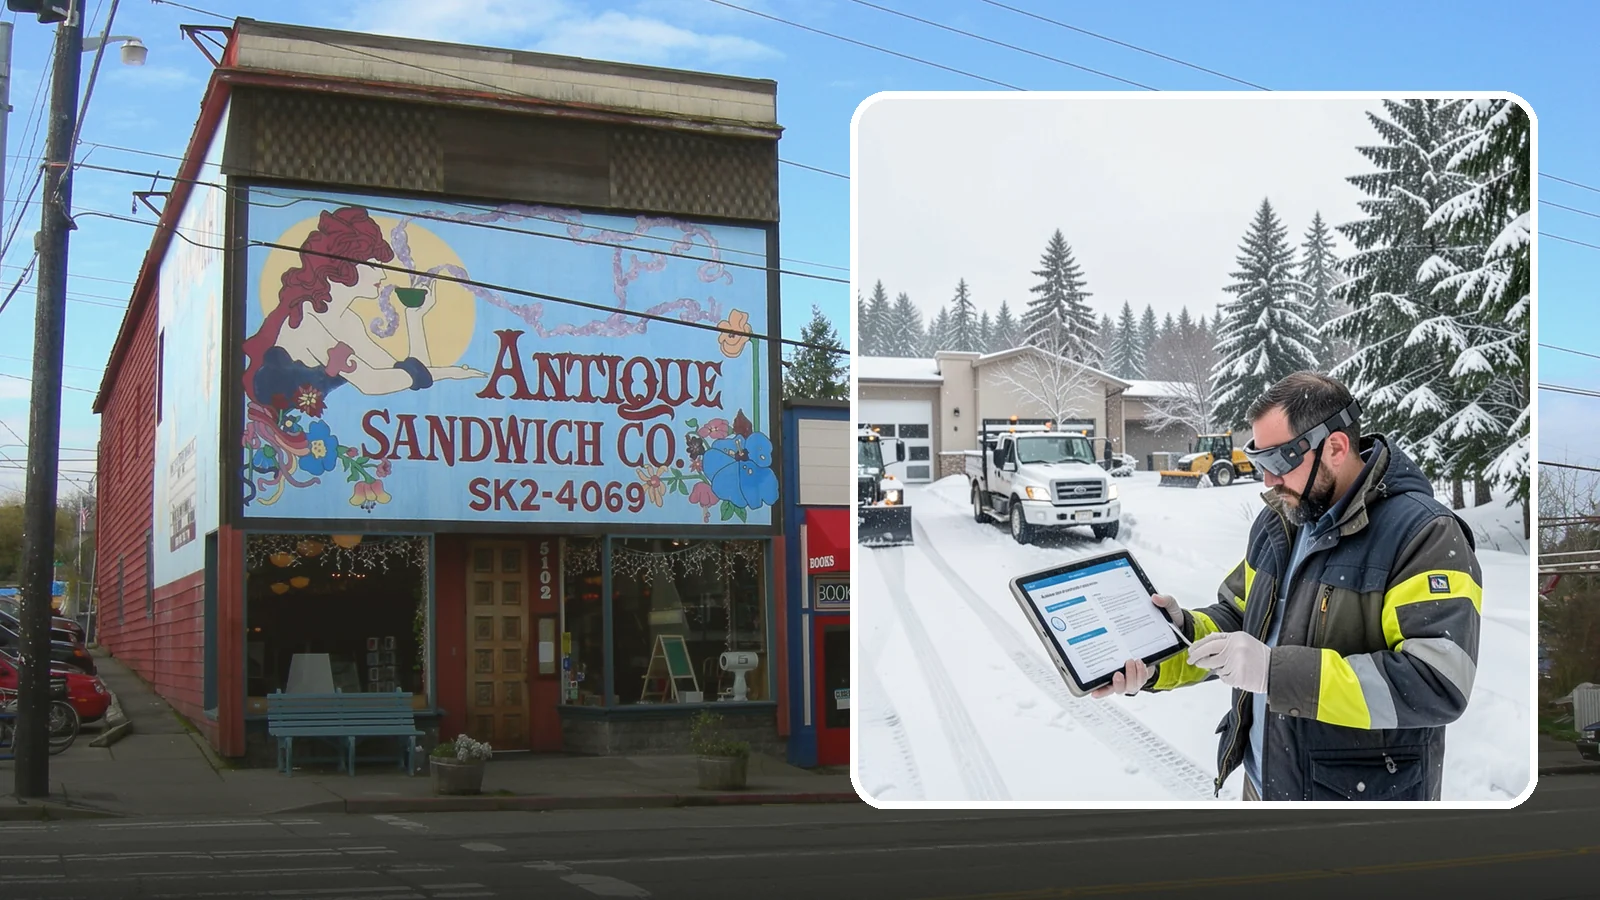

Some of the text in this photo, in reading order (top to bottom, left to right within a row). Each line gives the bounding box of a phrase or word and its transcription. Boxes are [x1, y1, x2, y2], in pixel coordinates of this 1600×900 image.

[475, 329, 724, 421] ANTIQUE
[361, 408, 685, 468] SANDWICH CO.
[468, 477, 646, 513] SK2-4069
[539, 541, 551, 600] 5102
[809, 555, 835, 569] BOOKS
